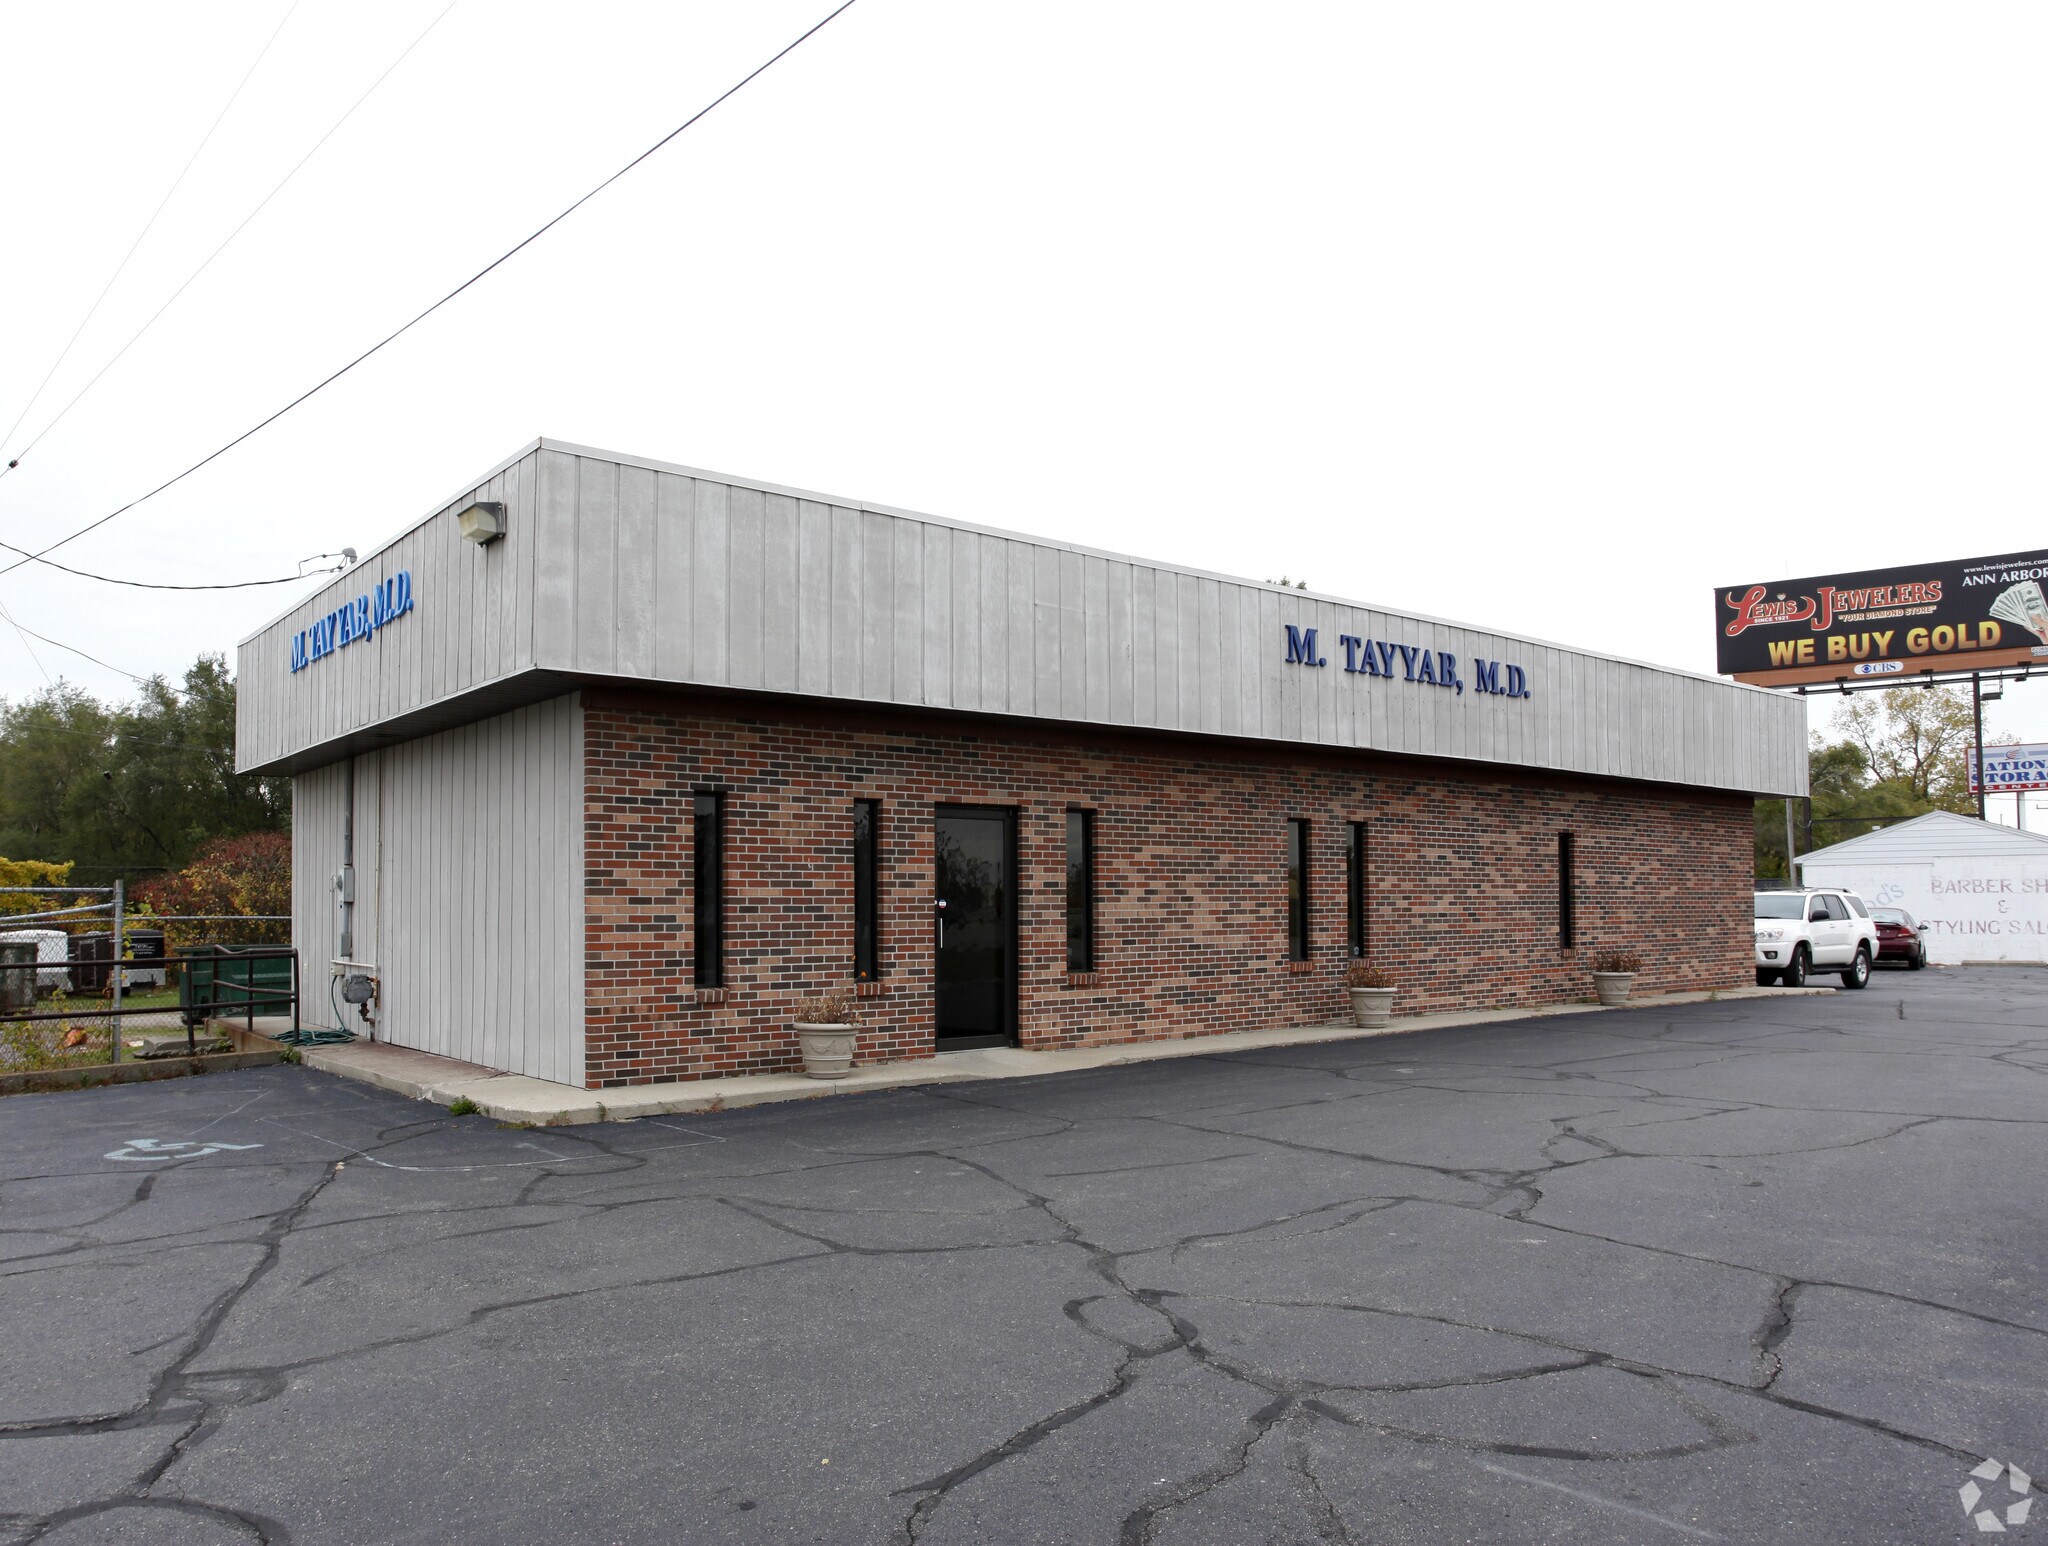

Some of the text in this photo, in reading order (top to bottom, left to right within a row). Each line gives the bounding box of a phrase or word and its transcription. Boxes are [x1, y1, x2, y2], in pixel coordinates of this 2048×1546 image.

[1963, 559, 2048, 573] www.lewisjewelers.com
[1962, 573, 1996, 587] ANN
[1865, 608, 1904, 620] DIAMOND
[1768, 620, 2002, 666] WE BUY GOLD
[290, 630, 309, 673] M.
[1285, 624, 1531, 699] M. TAYYAB, M.D.
[1873, 662, 1897, 672] CBS
[1971, 759, 2048, 772] ATION
[1971, 770, 2048, 784] STORA
[1931, 879, 2013, 894] BARBER
[1921, 919, 2048, 935] STYLING SAL
